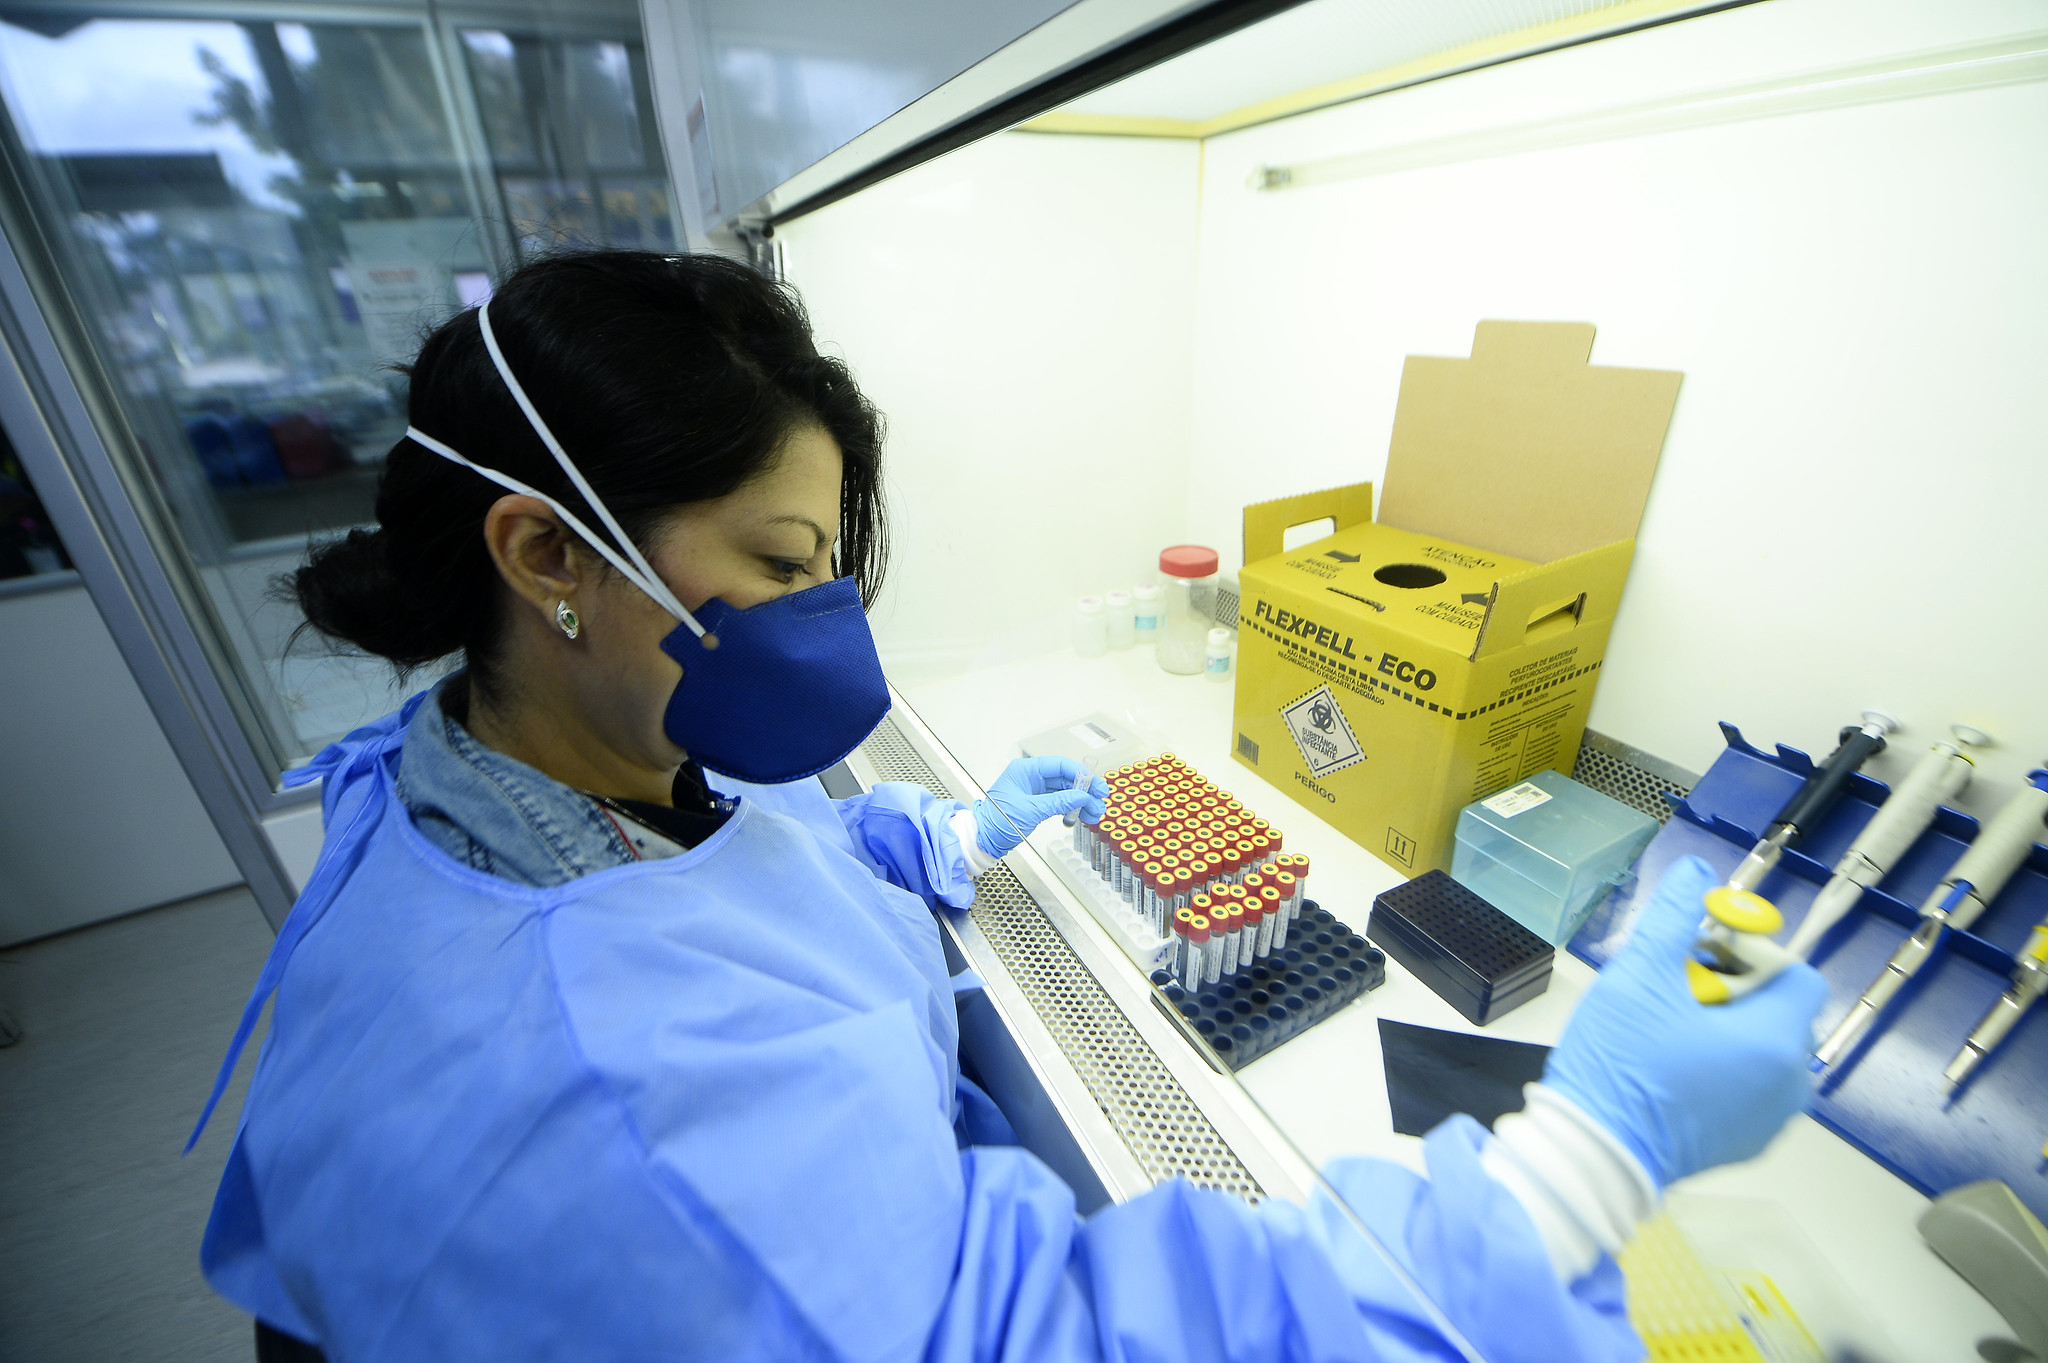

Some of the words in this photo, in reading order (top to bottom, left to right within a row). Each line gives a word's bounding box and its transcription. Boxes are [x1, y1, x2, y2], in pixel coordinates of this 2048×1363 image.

[1415, 604, 1438, 615] COM
[1436, 612, 1480, 629] CUIDADO
[1254, 599, 1356, 660] FLEXPELL
[1377, 652, 1437, 691] ECO
[1320, 664, 1337, 676] ACIMA
[1337, 672, 1356, 685] DESTA
[1509, 661, 1539, 678] COLETOR
[1539, 657, 1548, 667] DE
[1549, 646, 1579, 663] MATERIAIS
[1321, 671, 1351, 691] DESCARTE
[1351, 685, 1385, 706] ADEQUADO
[1500, 679, 1537, 698] RECIPIENTE
[1302, 727, 1338, 754] SUBSTÂNCIA
[1302, 733, 1337, 760] INFECTANTE
[1313, 758, 1319, 767] 6
[1294, 771, 1336, 804] PERIGO
